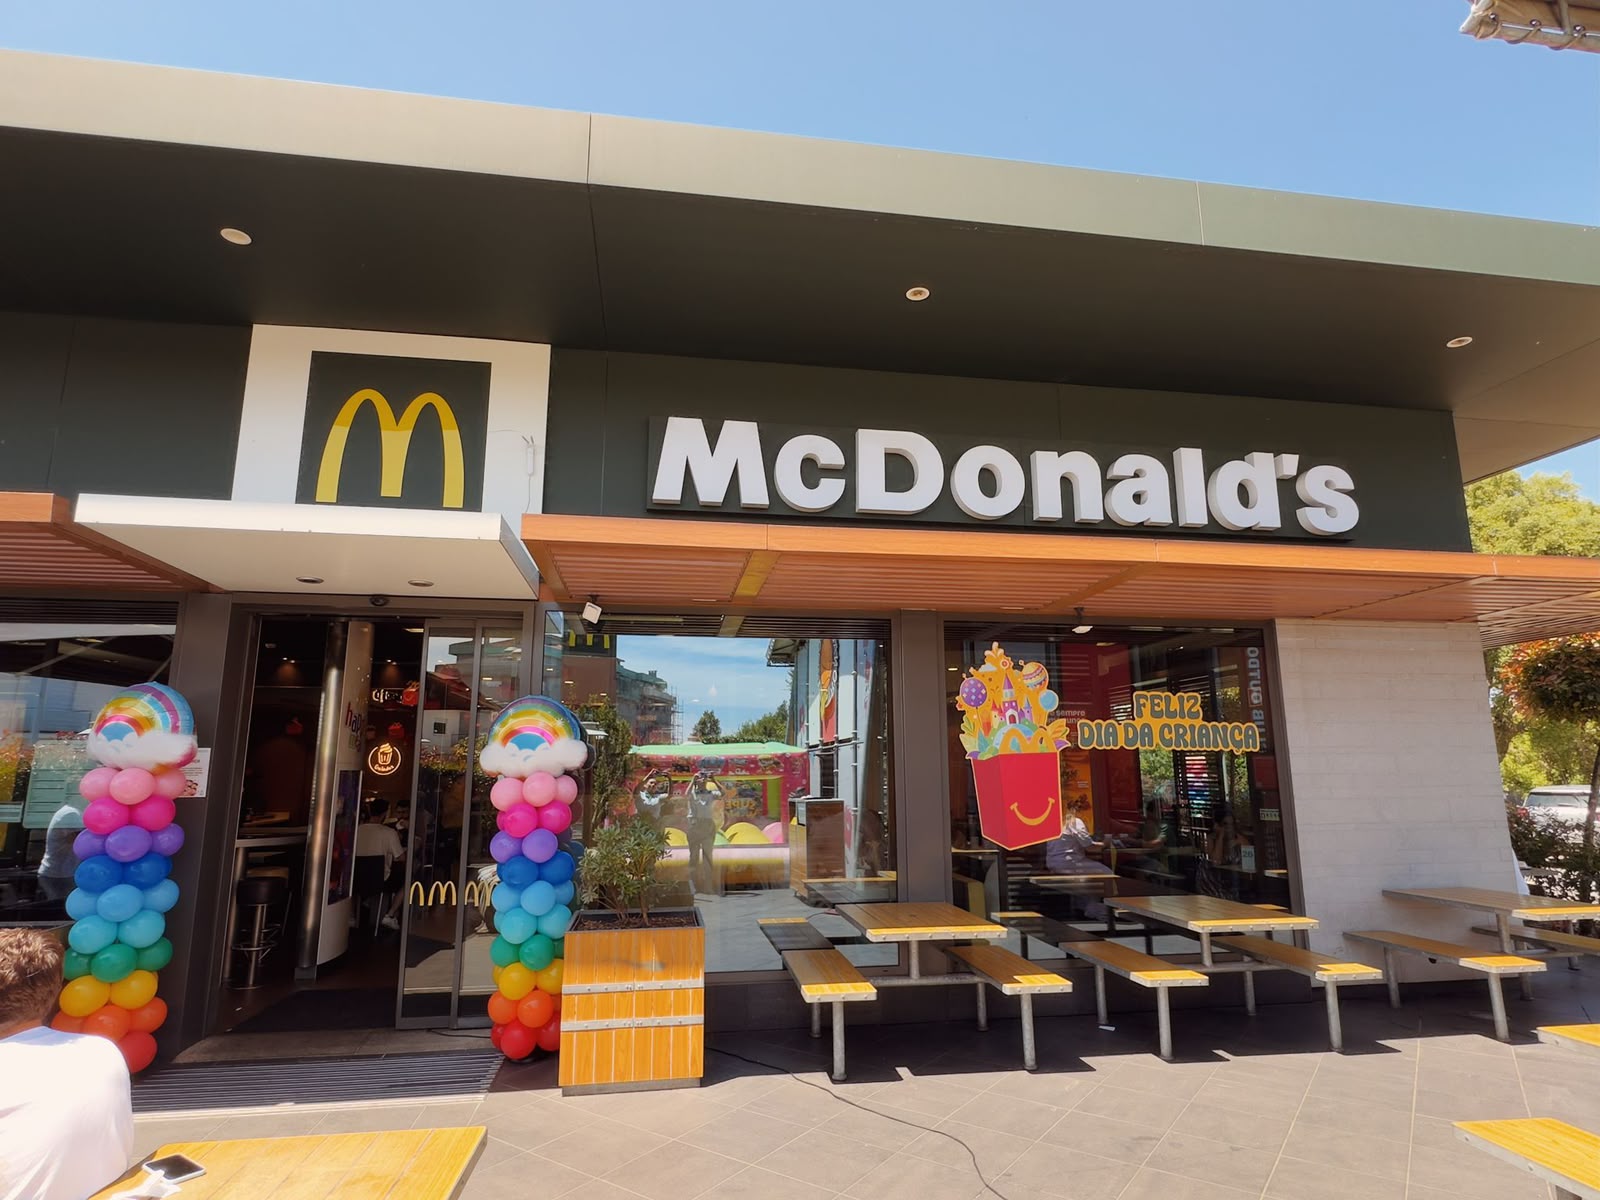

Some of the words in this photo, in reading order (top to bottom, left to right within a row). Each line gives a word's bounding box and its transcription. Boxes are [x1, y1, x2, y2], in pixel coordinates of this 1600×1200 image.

[650, 416, 1361, 536] McDonald's
[1134, 693, 1202, 720] FELIZ
[1077, 721, 1119, 748] DIA
[1122, 722, 1155, 749] DA
[1158, 722, 1260, 753] CRIANÇA
